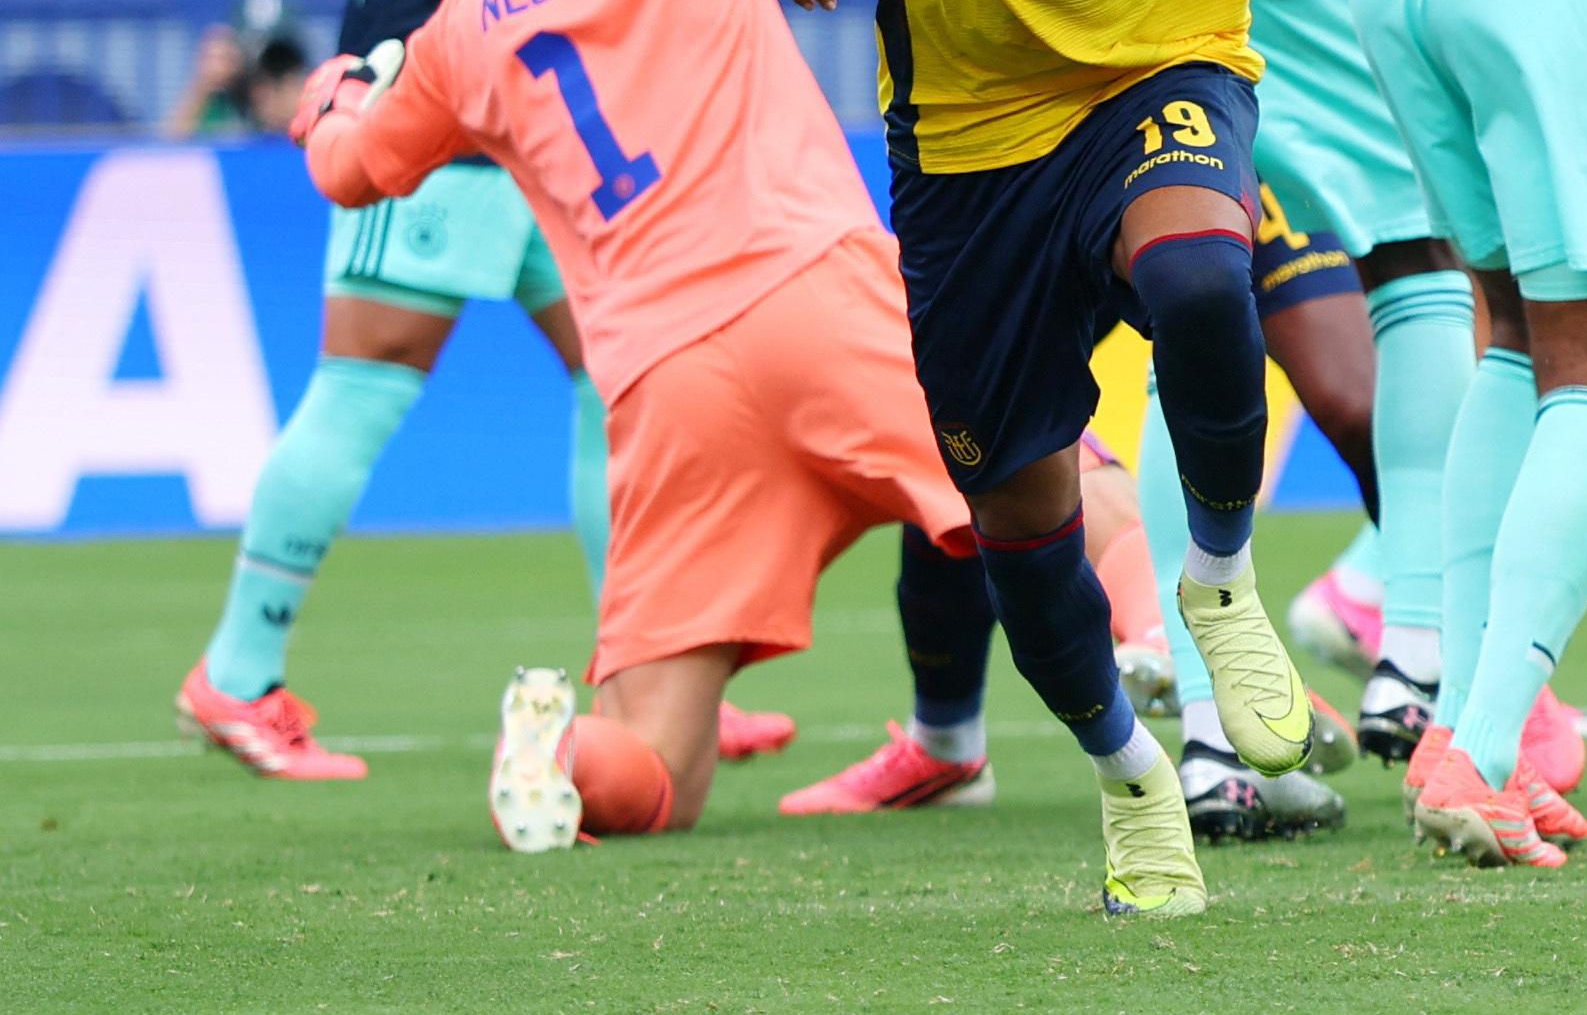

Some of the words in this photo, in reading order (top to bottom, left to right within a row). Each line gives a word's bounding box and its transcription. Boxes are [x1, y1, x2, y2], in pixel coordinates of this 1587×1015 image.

[515, 30, 661, 222] 1
[1136, 100, 1217, 155] 19
[1124, 150, 1224, 189] marathon
